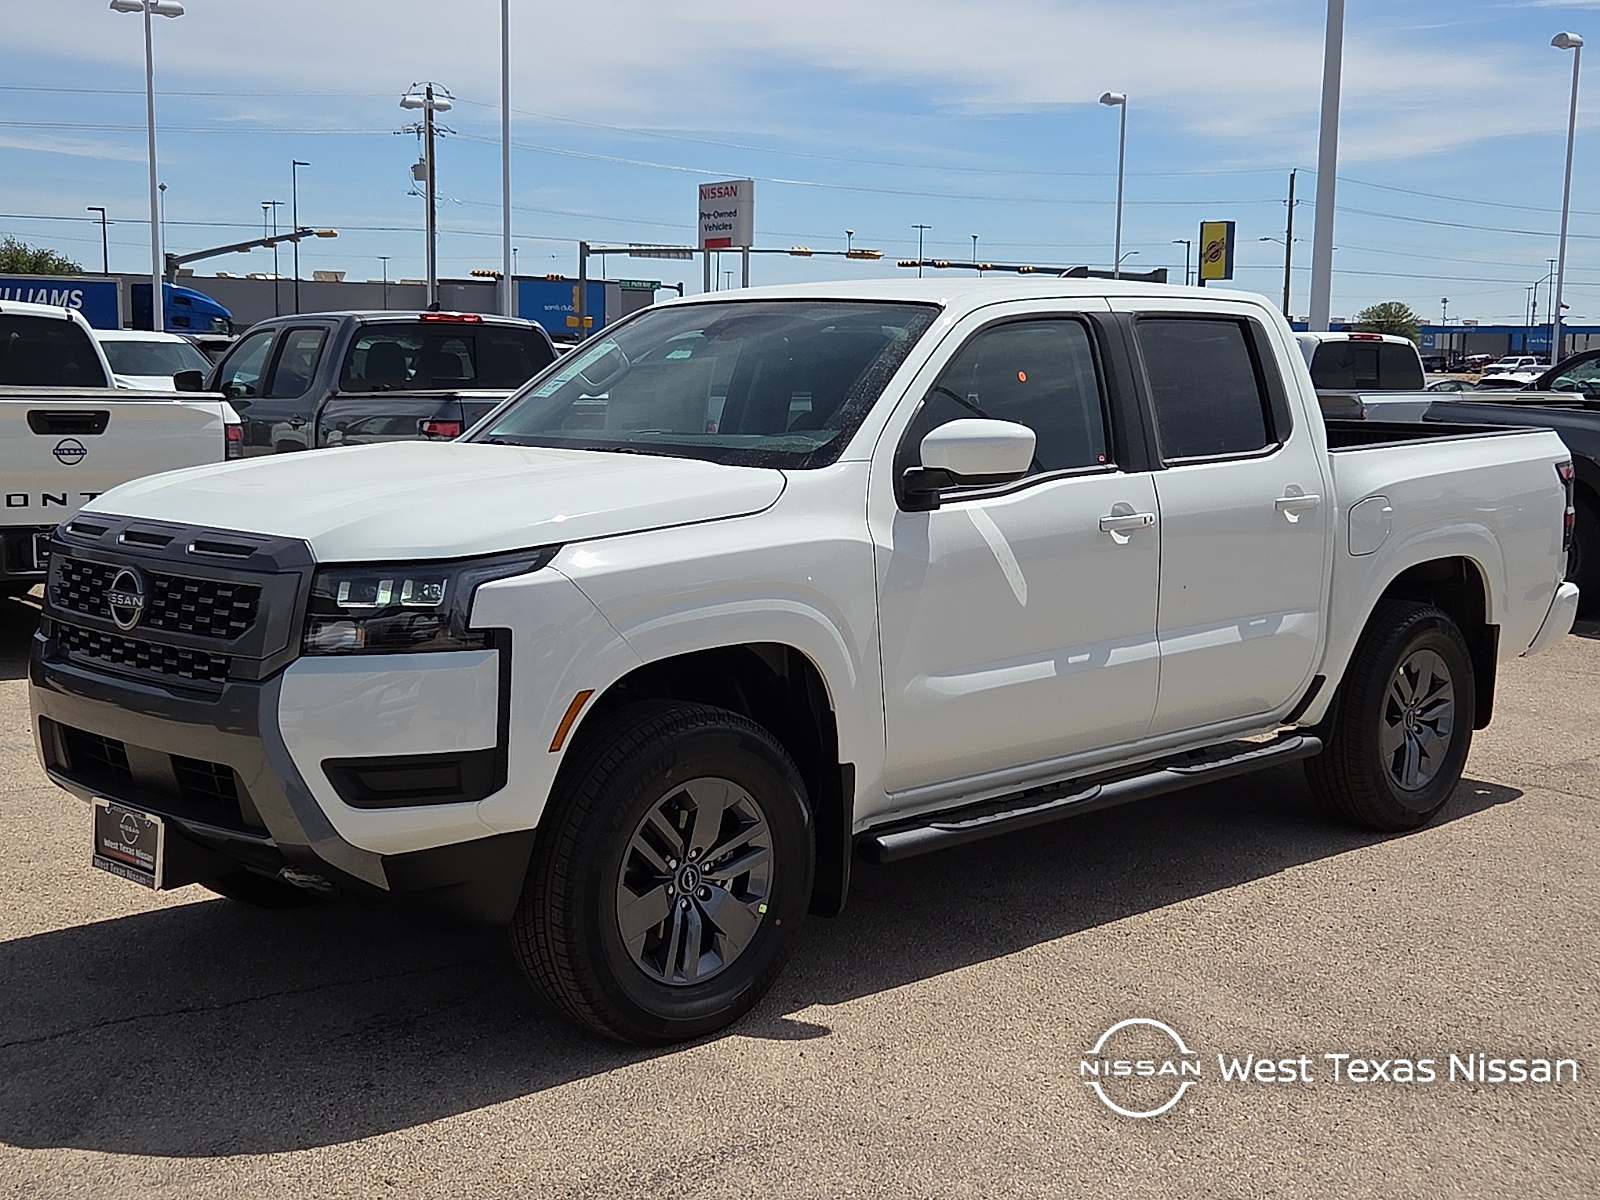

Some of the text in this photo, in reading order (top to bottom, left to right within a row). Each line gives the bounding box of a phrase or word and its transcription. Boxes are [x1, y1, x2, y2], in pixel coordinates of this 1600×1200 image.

[700, 185, 738, 200] NISSAN
[700, 208, 738, 220] Pre-Owned
[704, 222, 733, 232] Vehicles
[0, 287, 84, 309] LLIAMS
[560, 304, 574, 312] club
[109, 592, 143, 607] SSAN
[119, 823, 140, 835] NISSAN
[103, 837, 154, 863] West Texas Nissan
[94, 857, 110, 870] West
[109, 862, 126, 878] Texas
[126, 868, 146, 885] Nissan
